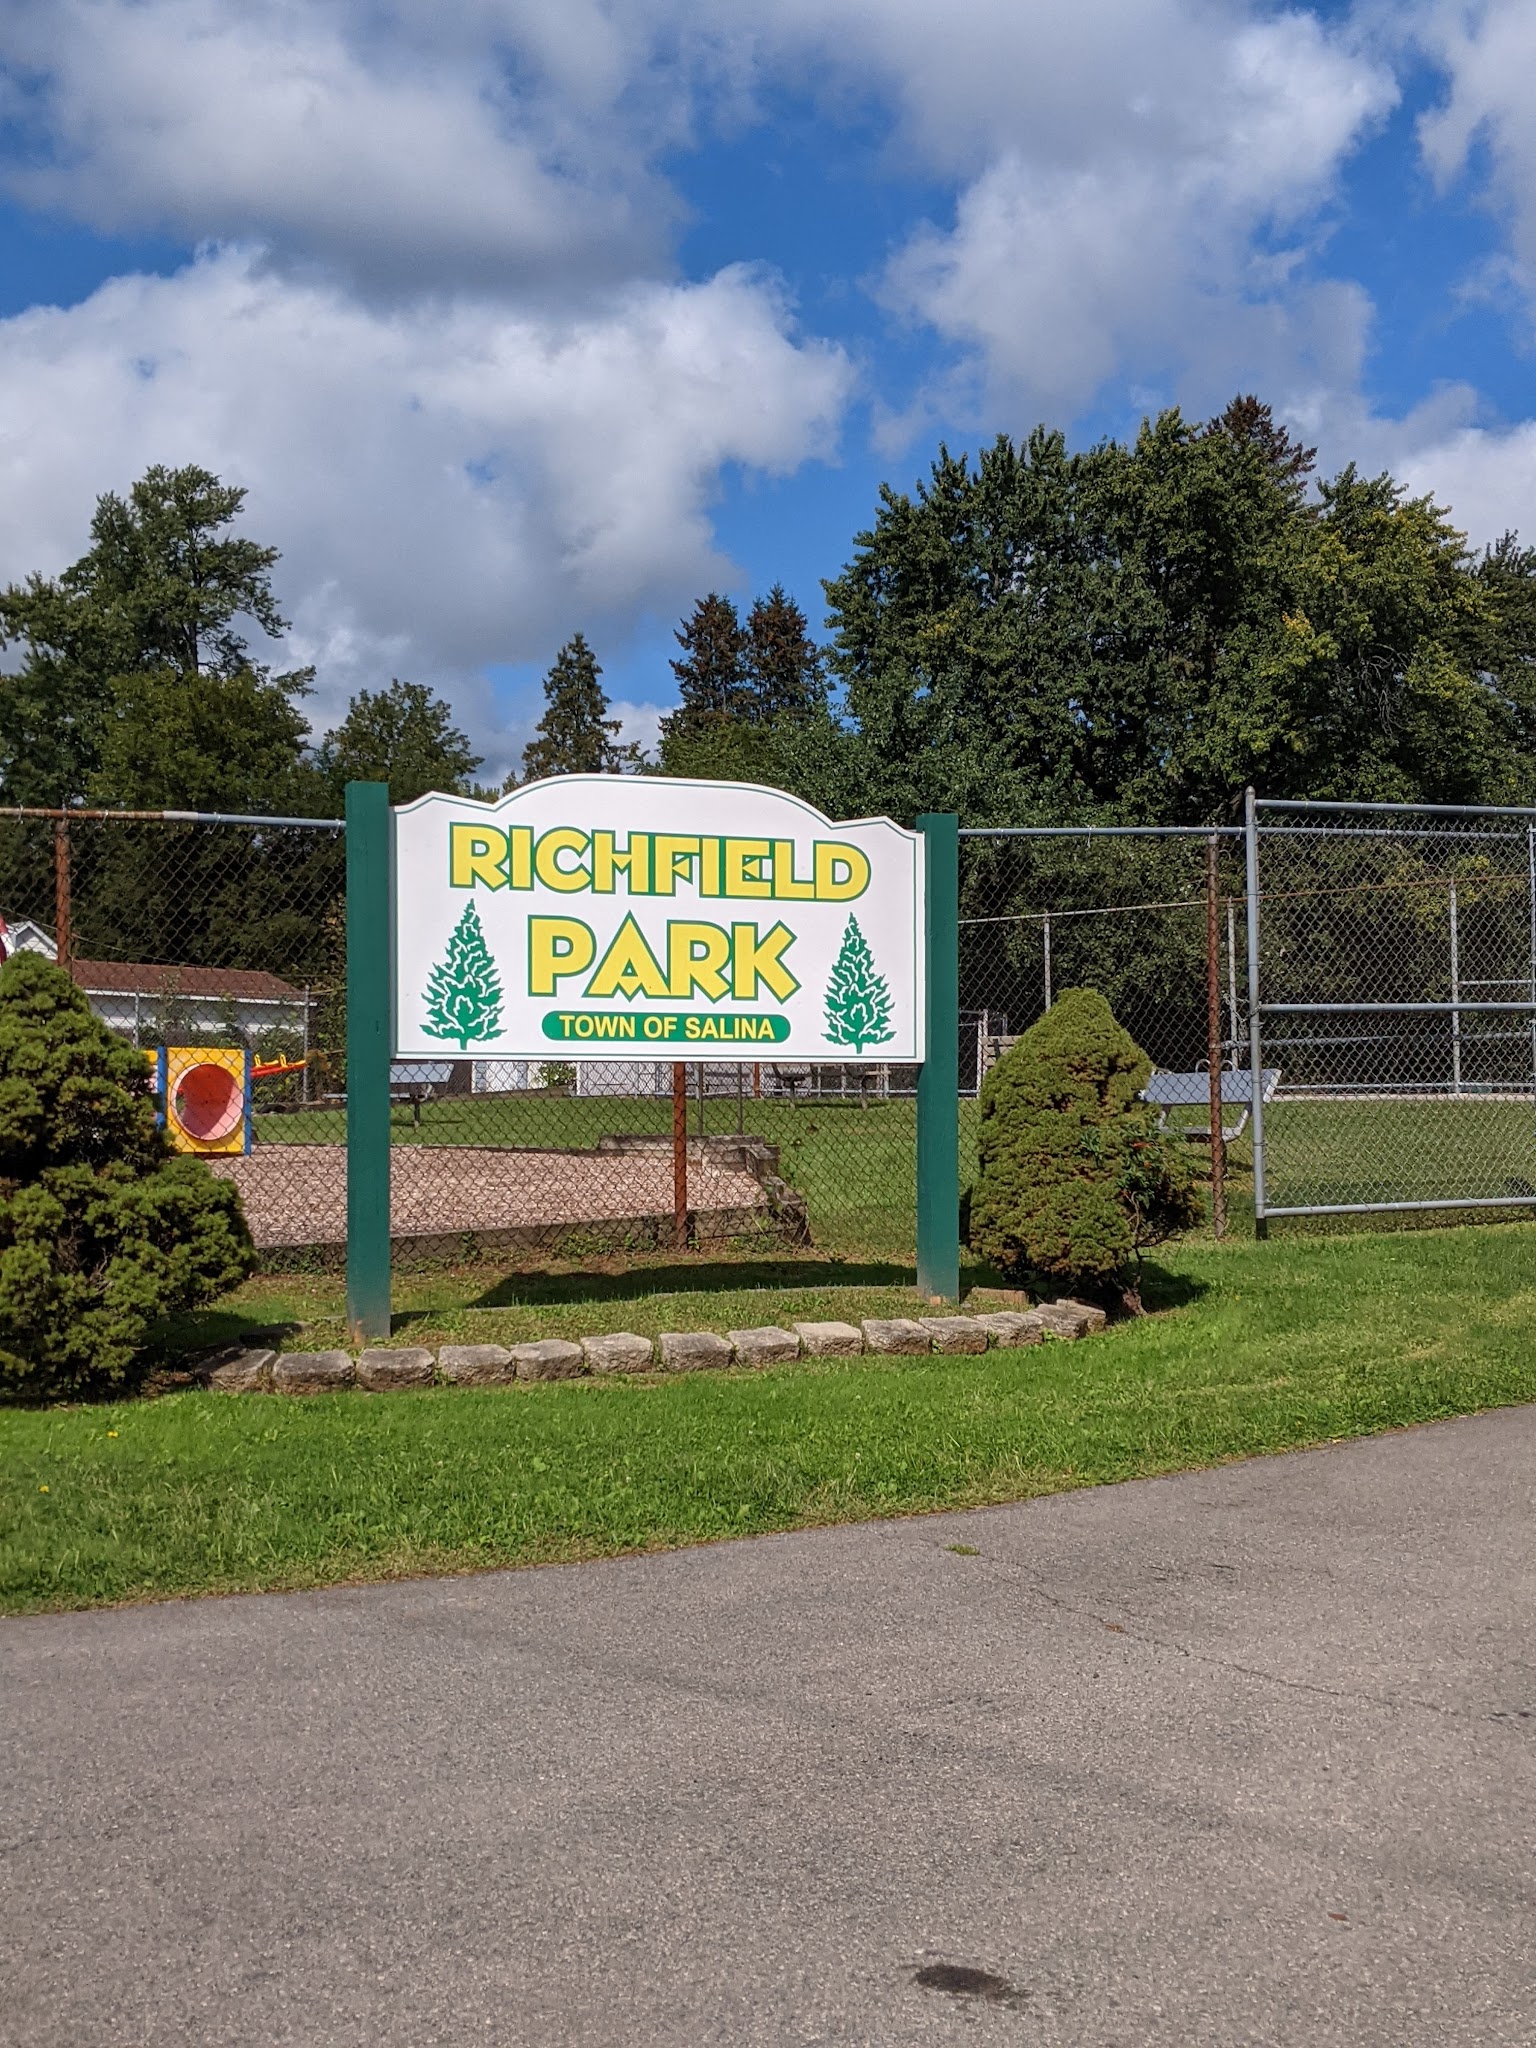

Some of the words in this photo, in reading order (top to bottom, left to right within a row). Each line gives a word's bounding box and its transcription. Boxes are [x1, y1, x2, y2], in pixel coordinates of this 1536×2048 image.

[450, 821, 872, 903] RICHFIELD
[527, 910, 802, 1004] PARK
[559, 1015, 635, 1038] TOWN
[643, 1015, 678, 1039] OF
[685, 1016, 775, 1040] SALINA
